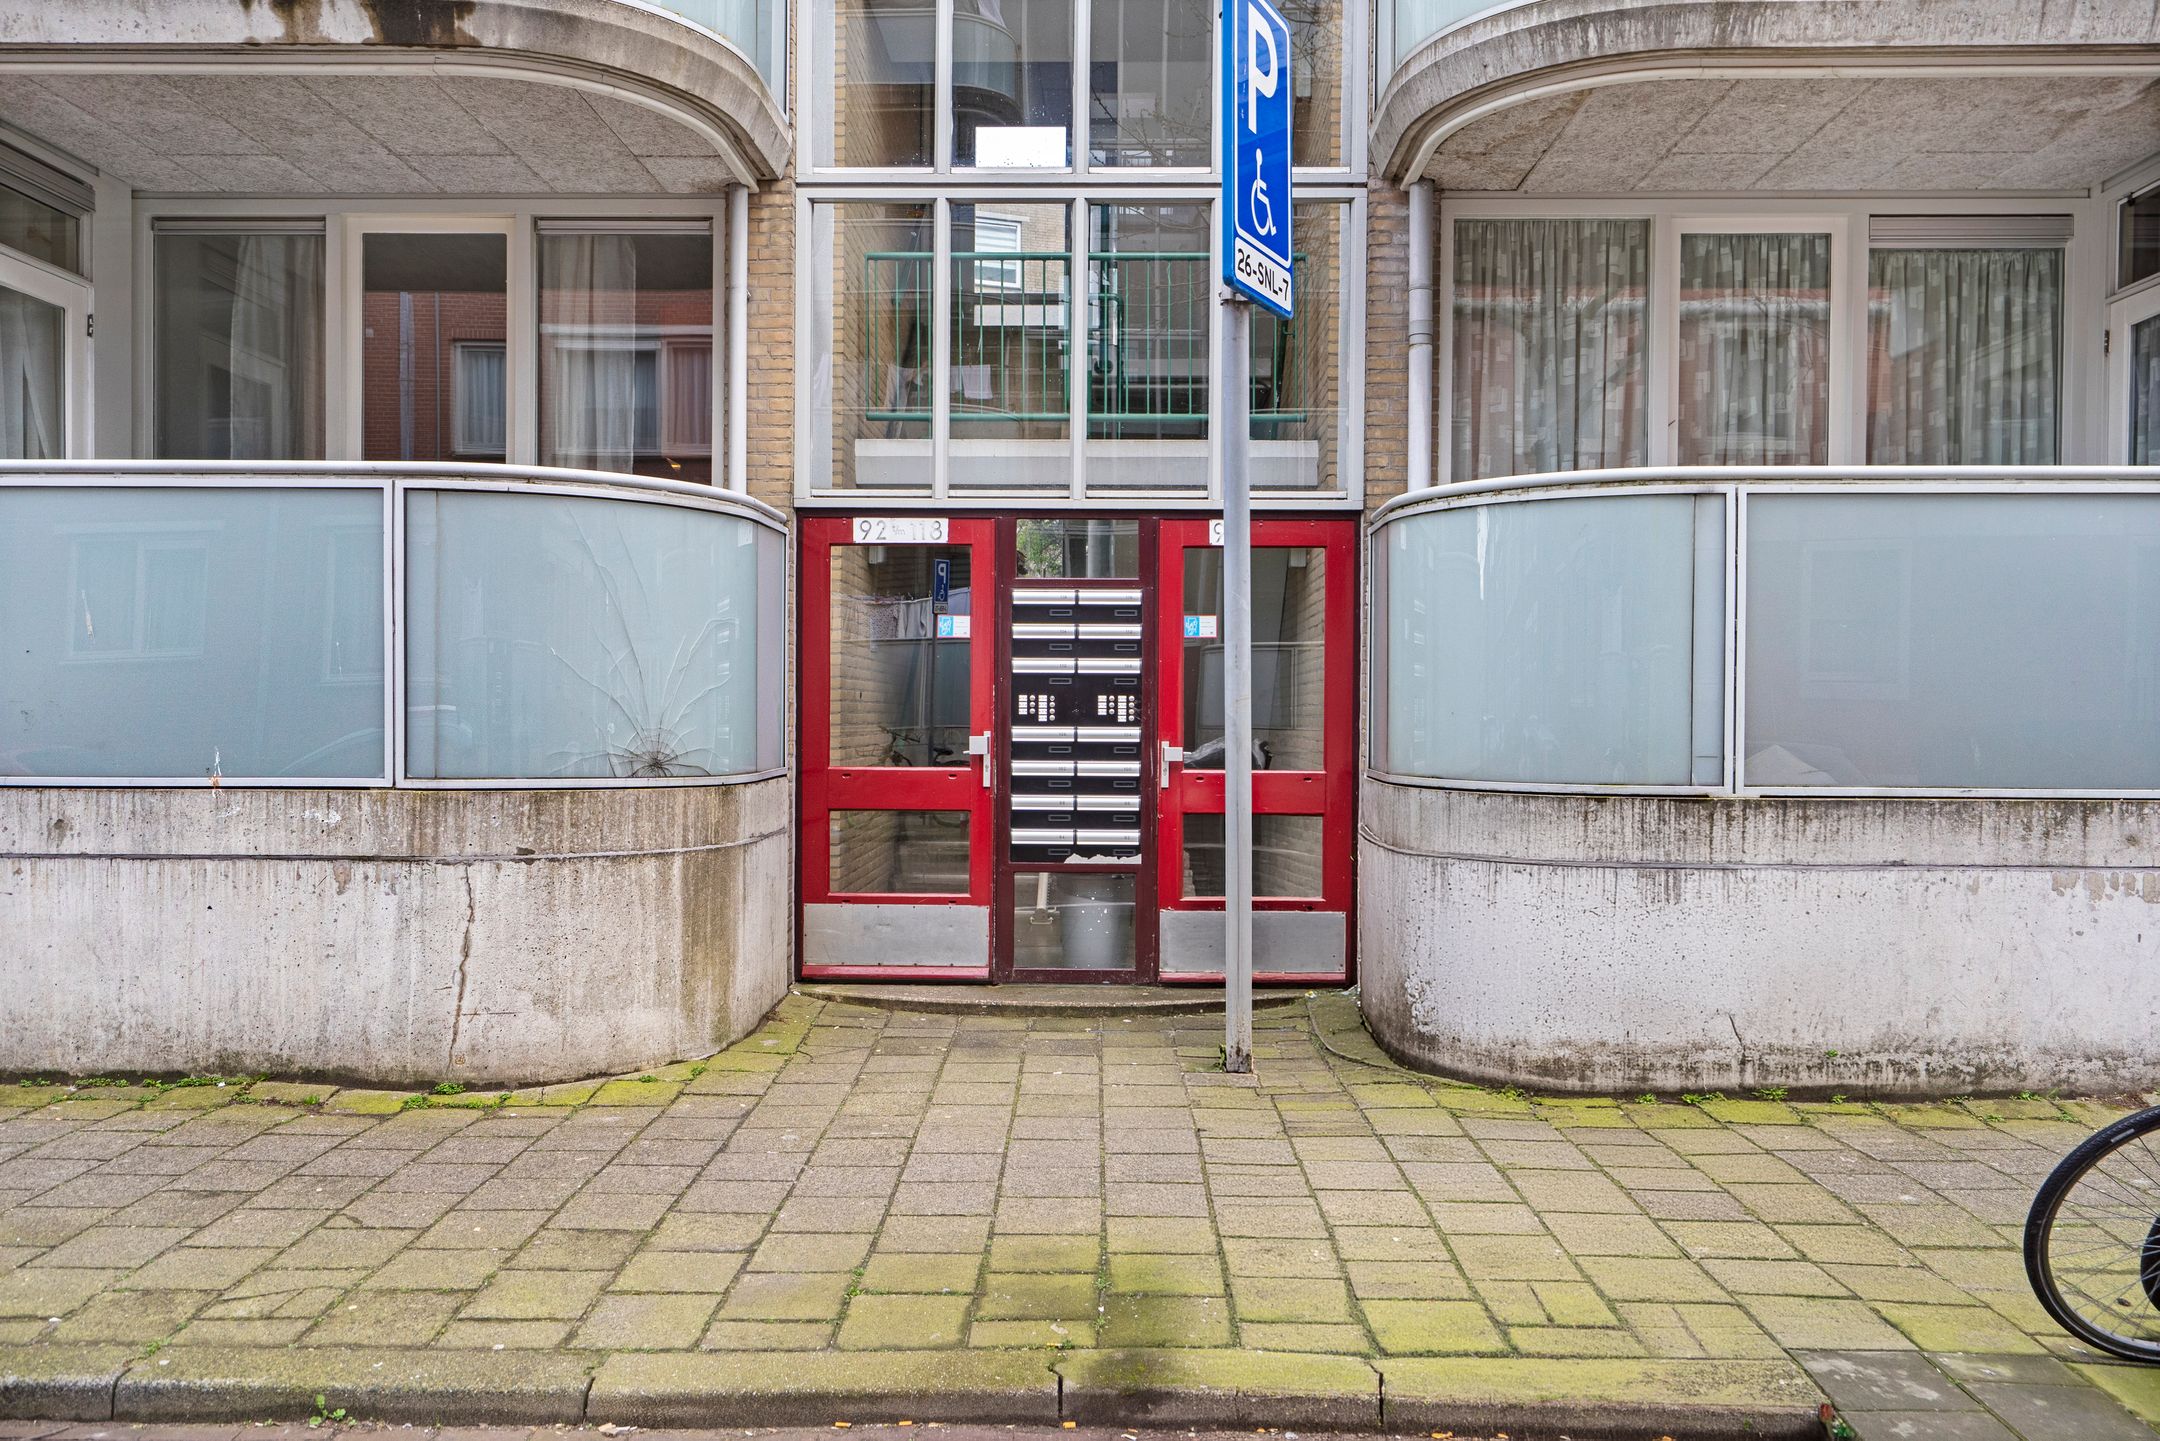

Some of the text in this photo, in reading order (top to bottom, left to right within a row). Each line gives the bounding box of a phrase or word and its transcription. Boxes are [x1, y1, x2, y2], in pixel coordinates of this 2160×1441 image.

[1248, 2, 1279, 134] P
[1237, 247, 1289, 302] 26-SNL-7
[860, 520, 887, 541] 92
